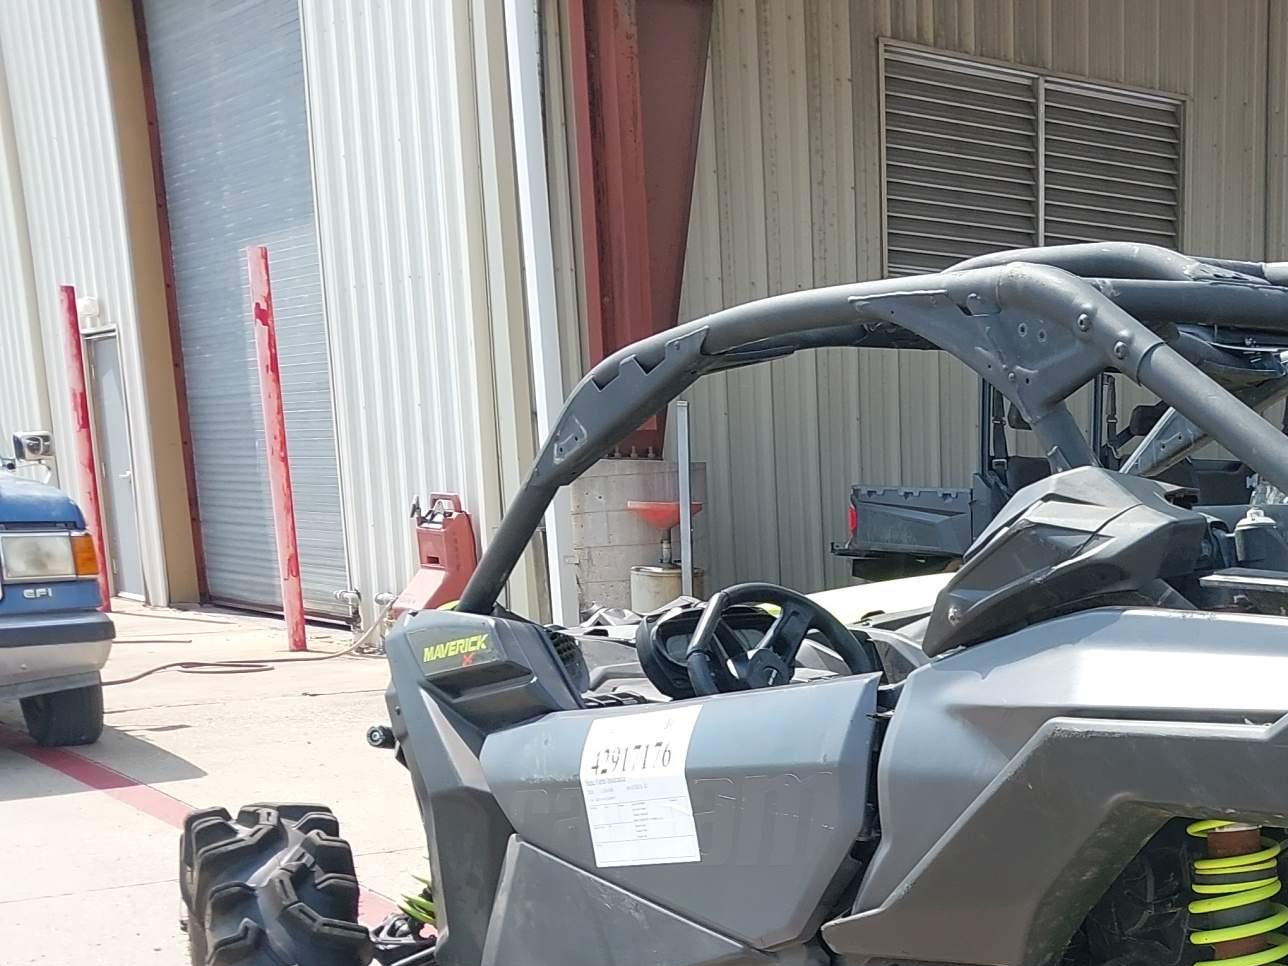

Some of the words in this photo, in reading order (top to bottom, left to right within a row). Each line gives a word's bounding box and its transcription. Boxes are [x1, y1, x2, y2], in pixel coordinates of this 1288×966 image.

[23, 587, 53, 599] EFI
[423, 633, 489, 663] MAVERICK
[591, 741, 672, 775] 42917176
